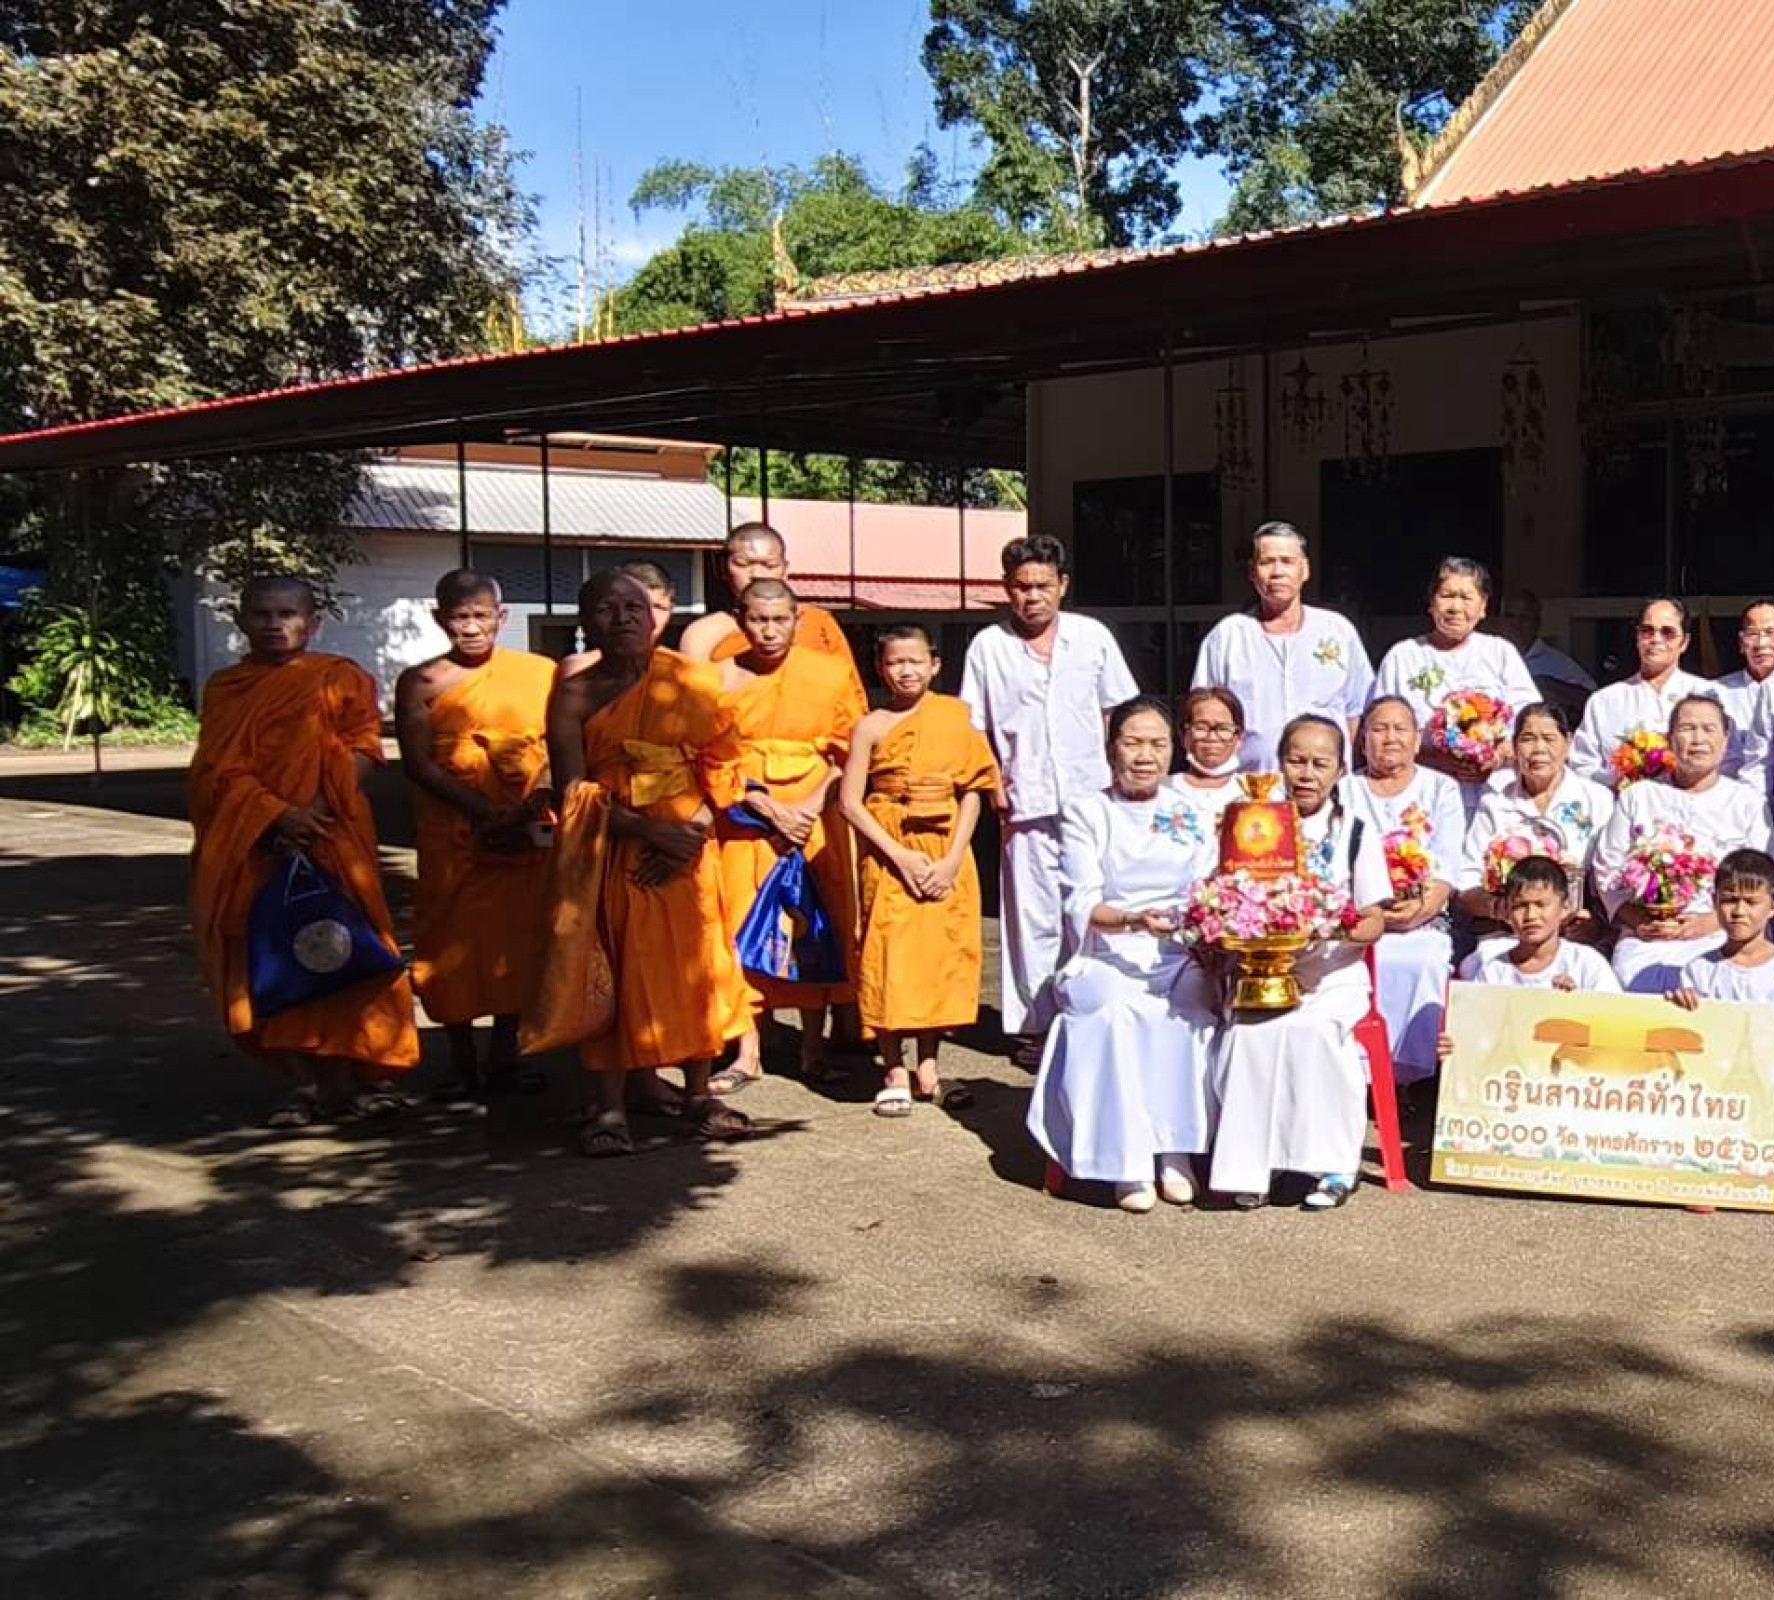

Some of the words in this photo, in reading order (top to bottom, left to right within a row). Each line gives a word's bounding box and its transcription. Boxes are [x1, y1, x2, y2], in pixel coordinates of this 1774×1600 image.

[1484, 1069, 1747, 1121] กฐินสามัคคีทั่วไทย
[1555, 1124, 1579, 1148] วัด
[1584, 1131, 1686, 1157] พุทธศักราช
